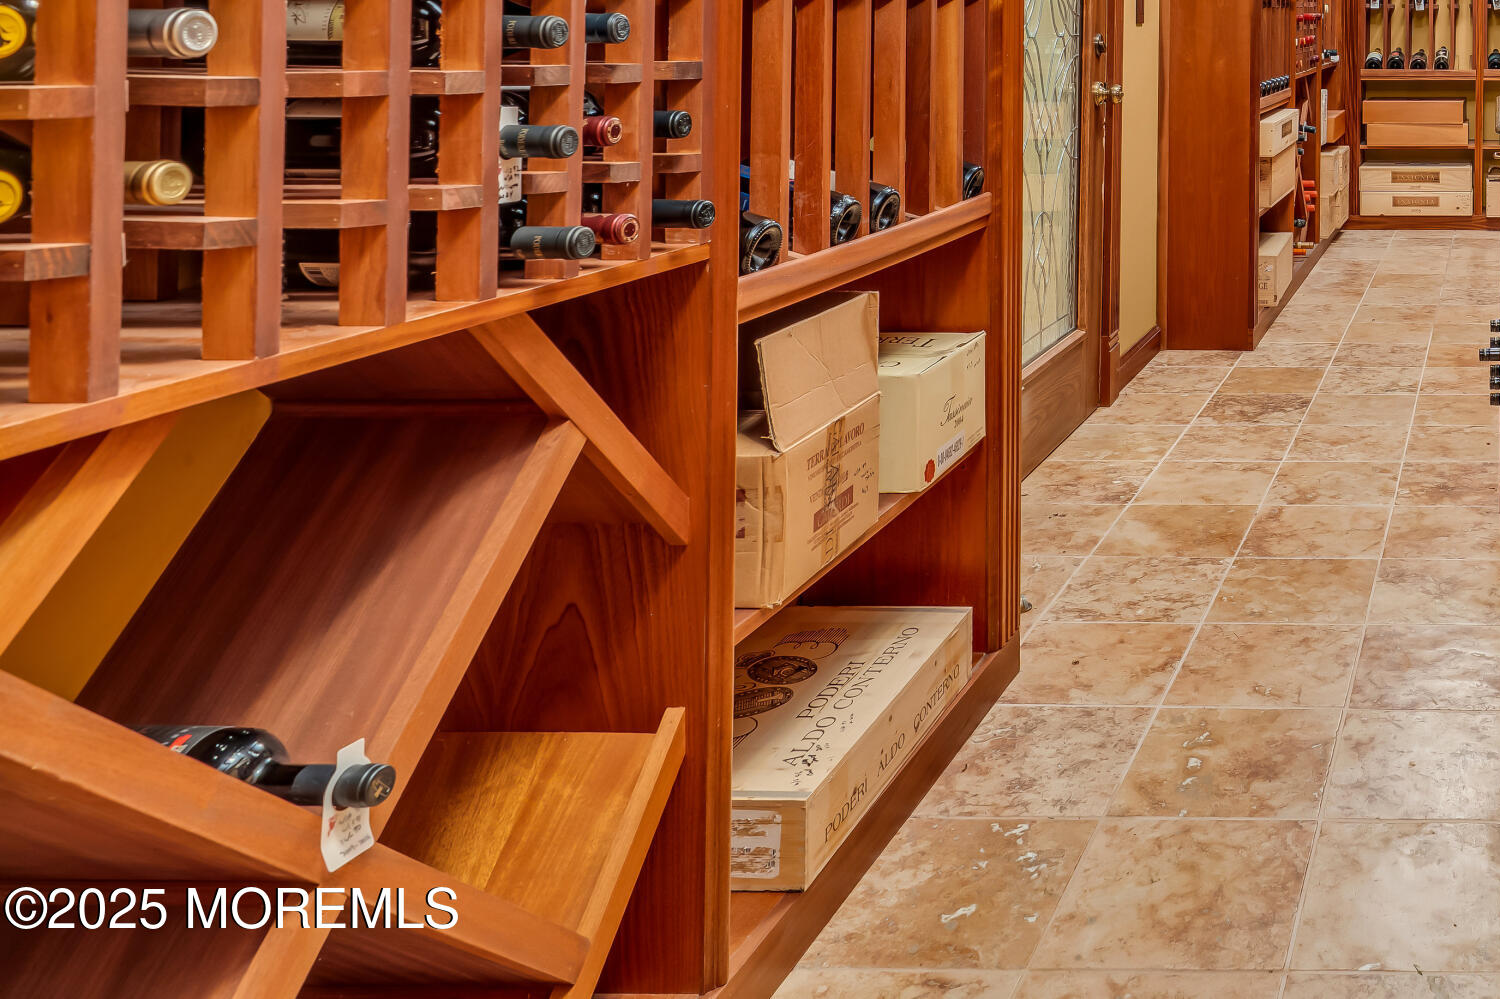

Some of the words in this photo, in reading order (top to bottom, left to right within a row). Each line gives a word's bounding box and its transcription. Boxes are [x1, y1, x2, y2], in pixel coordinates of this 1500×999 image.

[782, 716, 837, 769] ALDO
[833, 626, 920, 711] CONTERNO
[795, 660, 866, 720] PODERI
[824, 776, 869, 844] PODERI
[876, 732, 906, 777] ALDO
[913, 663, 961, 733] CONTERNO
